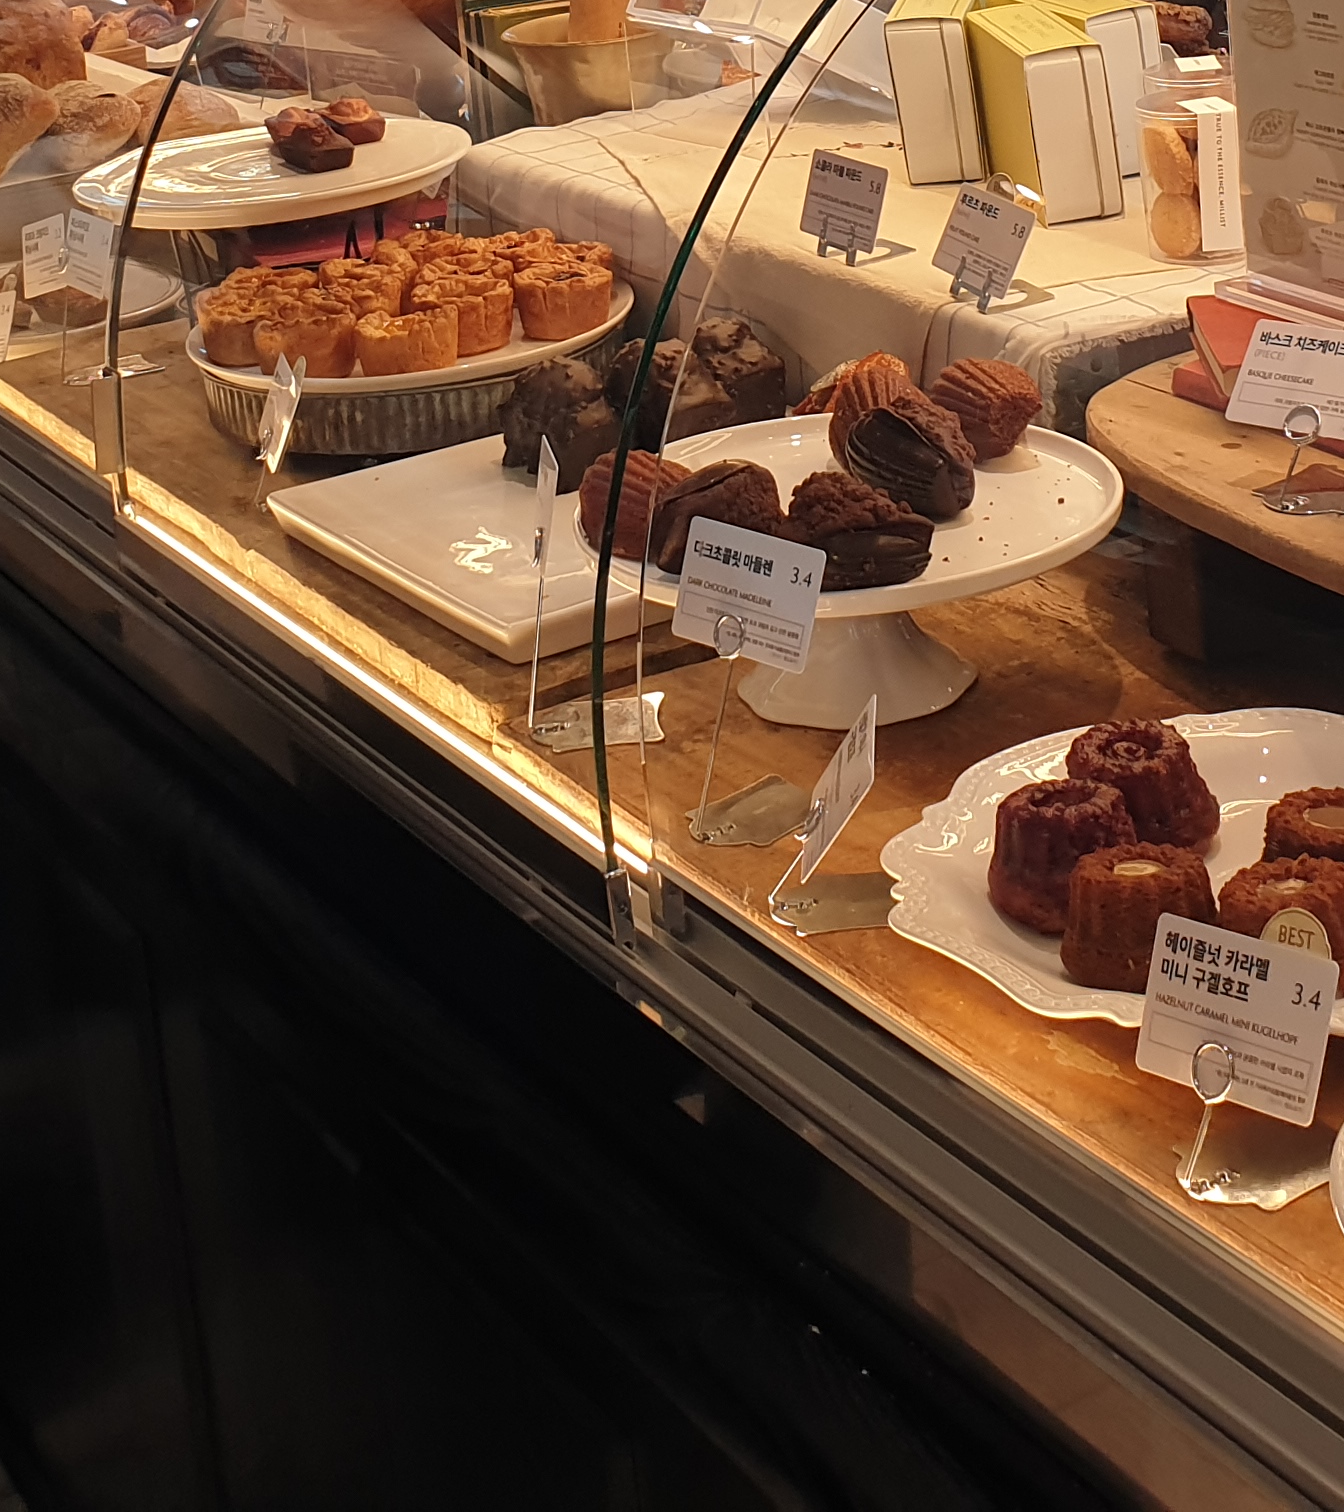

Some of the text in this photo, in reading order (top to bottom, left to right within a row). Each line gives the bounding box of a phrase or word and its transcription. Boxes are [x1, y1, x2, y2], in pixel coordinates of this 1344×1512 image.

[1216, 137, 1223, 146] TO
[869, 180, 882, 195] 5.8
[1010, 223, 1026, 239] 5.8
[1259, 330, 1294, 348] 바스크
[1247, 368, 1315, 386] BASQUE CHEESECAKE
[693, 539, 774, 578] 다크초콜릿 마들렌
[789, 566, 813, 588] 3.4
[703, 580, 739, 599] CHOCOLATE
[1277, 924, 1316, 950] BEST
[1164, 930, 1270, 982] 헤이즐넛 카라멜
[1160, 957, 1250, 1003] 미니 구겔호프
[1290, 982, 1322, 1011] 3.4
[1154, 990, 1193, 1013] HAZELNUT
[1194, 1003, 1231, 1026] CARAMEL
[1231, 1016, 1251, 1031] MINI
